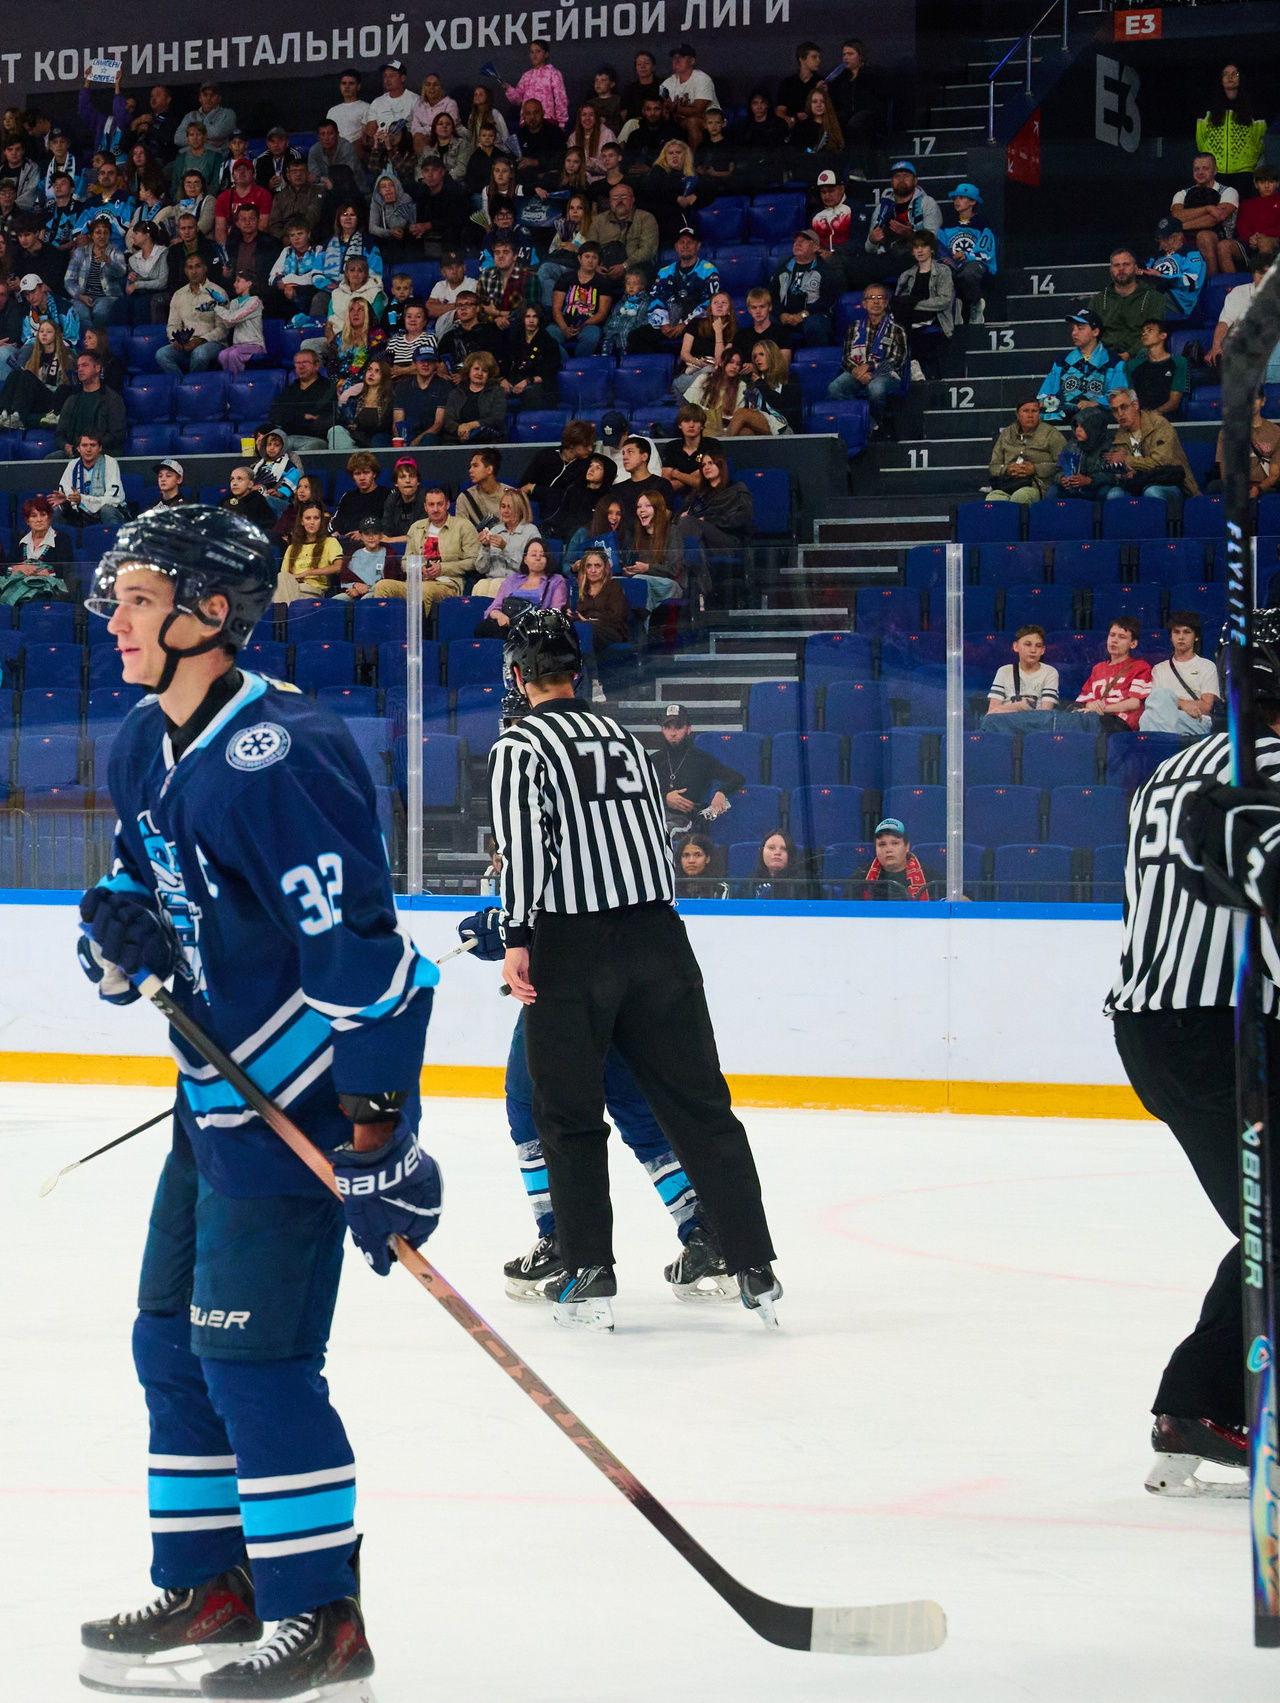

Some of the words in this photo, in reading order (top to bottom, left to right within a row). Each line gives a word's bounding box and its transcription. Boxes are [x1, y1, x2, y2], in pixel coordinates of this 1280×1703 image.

[1125, 14, 1156, 35] E3
[34, 13, 409, 82] КОНТИНЕНТАЛЬНОЙ
[424, 0, 666, 52] ХОККЕЙНОЙ
[1095, 53, 1141, 153] E3
[912, 137, 936, 155] 17
[1030, 274, 1055, 295] 14
[988, 330, 1015, 350] 13
[949, 387, 975, 408] 12
[907, 449, 929, 469] 11
[573, 741, 644, 794] 73
[280, 852, 343, 936] 32
[1241, 1149, 1263, 1290] BAUER
[186, 1601, 233, 1639] CCM
